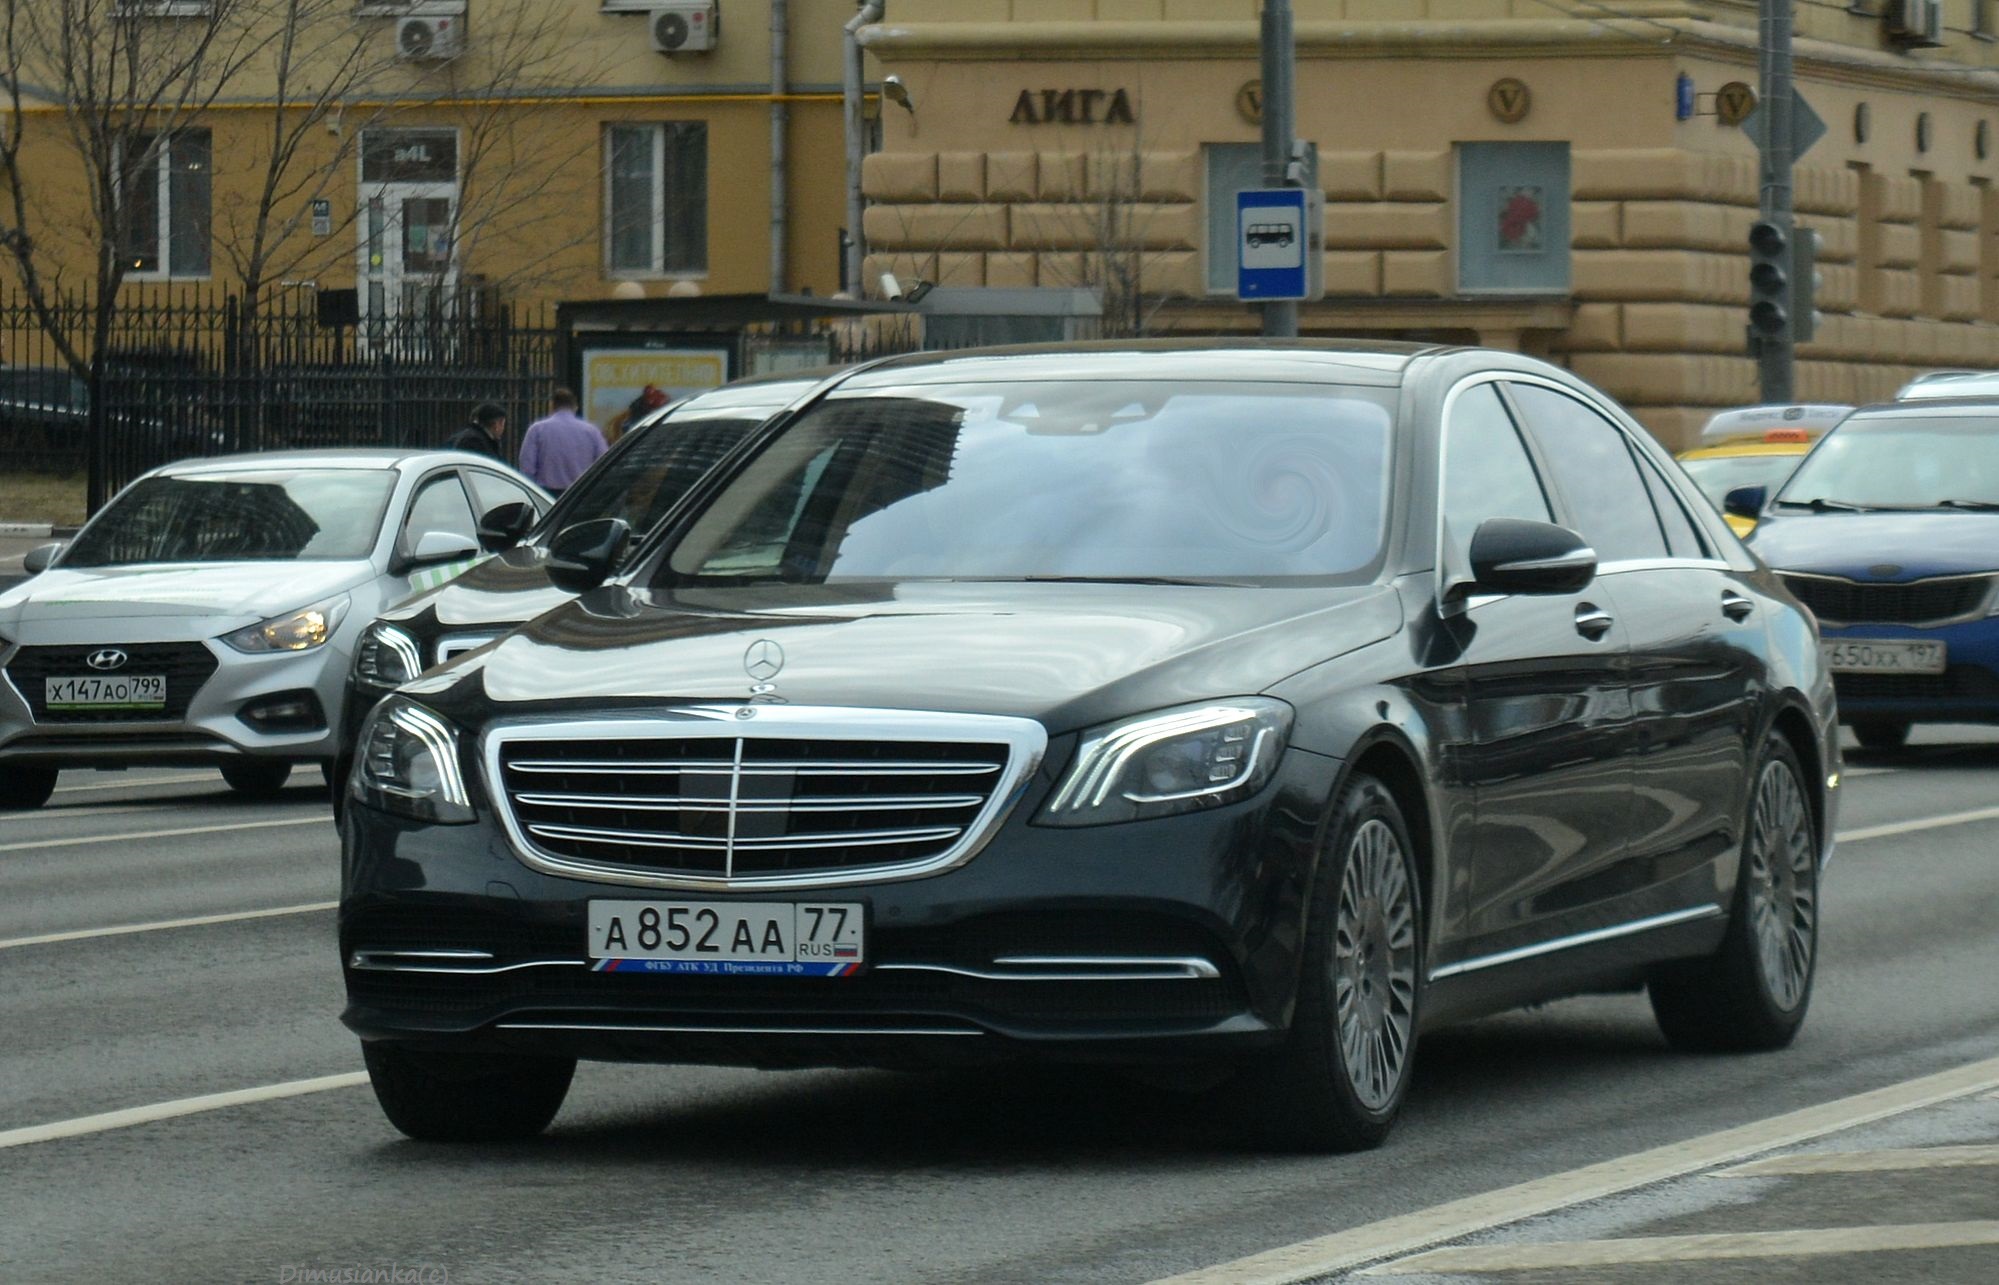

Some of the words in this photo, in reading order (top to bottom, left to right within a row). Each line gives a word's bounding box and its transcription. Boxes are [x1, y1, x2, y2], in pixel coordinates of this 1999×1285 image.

[1009, 88, 1136, 125] ЛИГА
[1497, 88, 1522, 113] V
[132, 678, 161, 694] 799
[804, 907, 849, 942] 77
[799, 943, 832, 957] RUS
[644, 960, 673, 971] ФГБУ
[677, 961, 699, 971] АТК
[703, 962, 719, 973] УД
[723, 962, 784, 974] Президента
[787, 963, 804, 973] РФ
